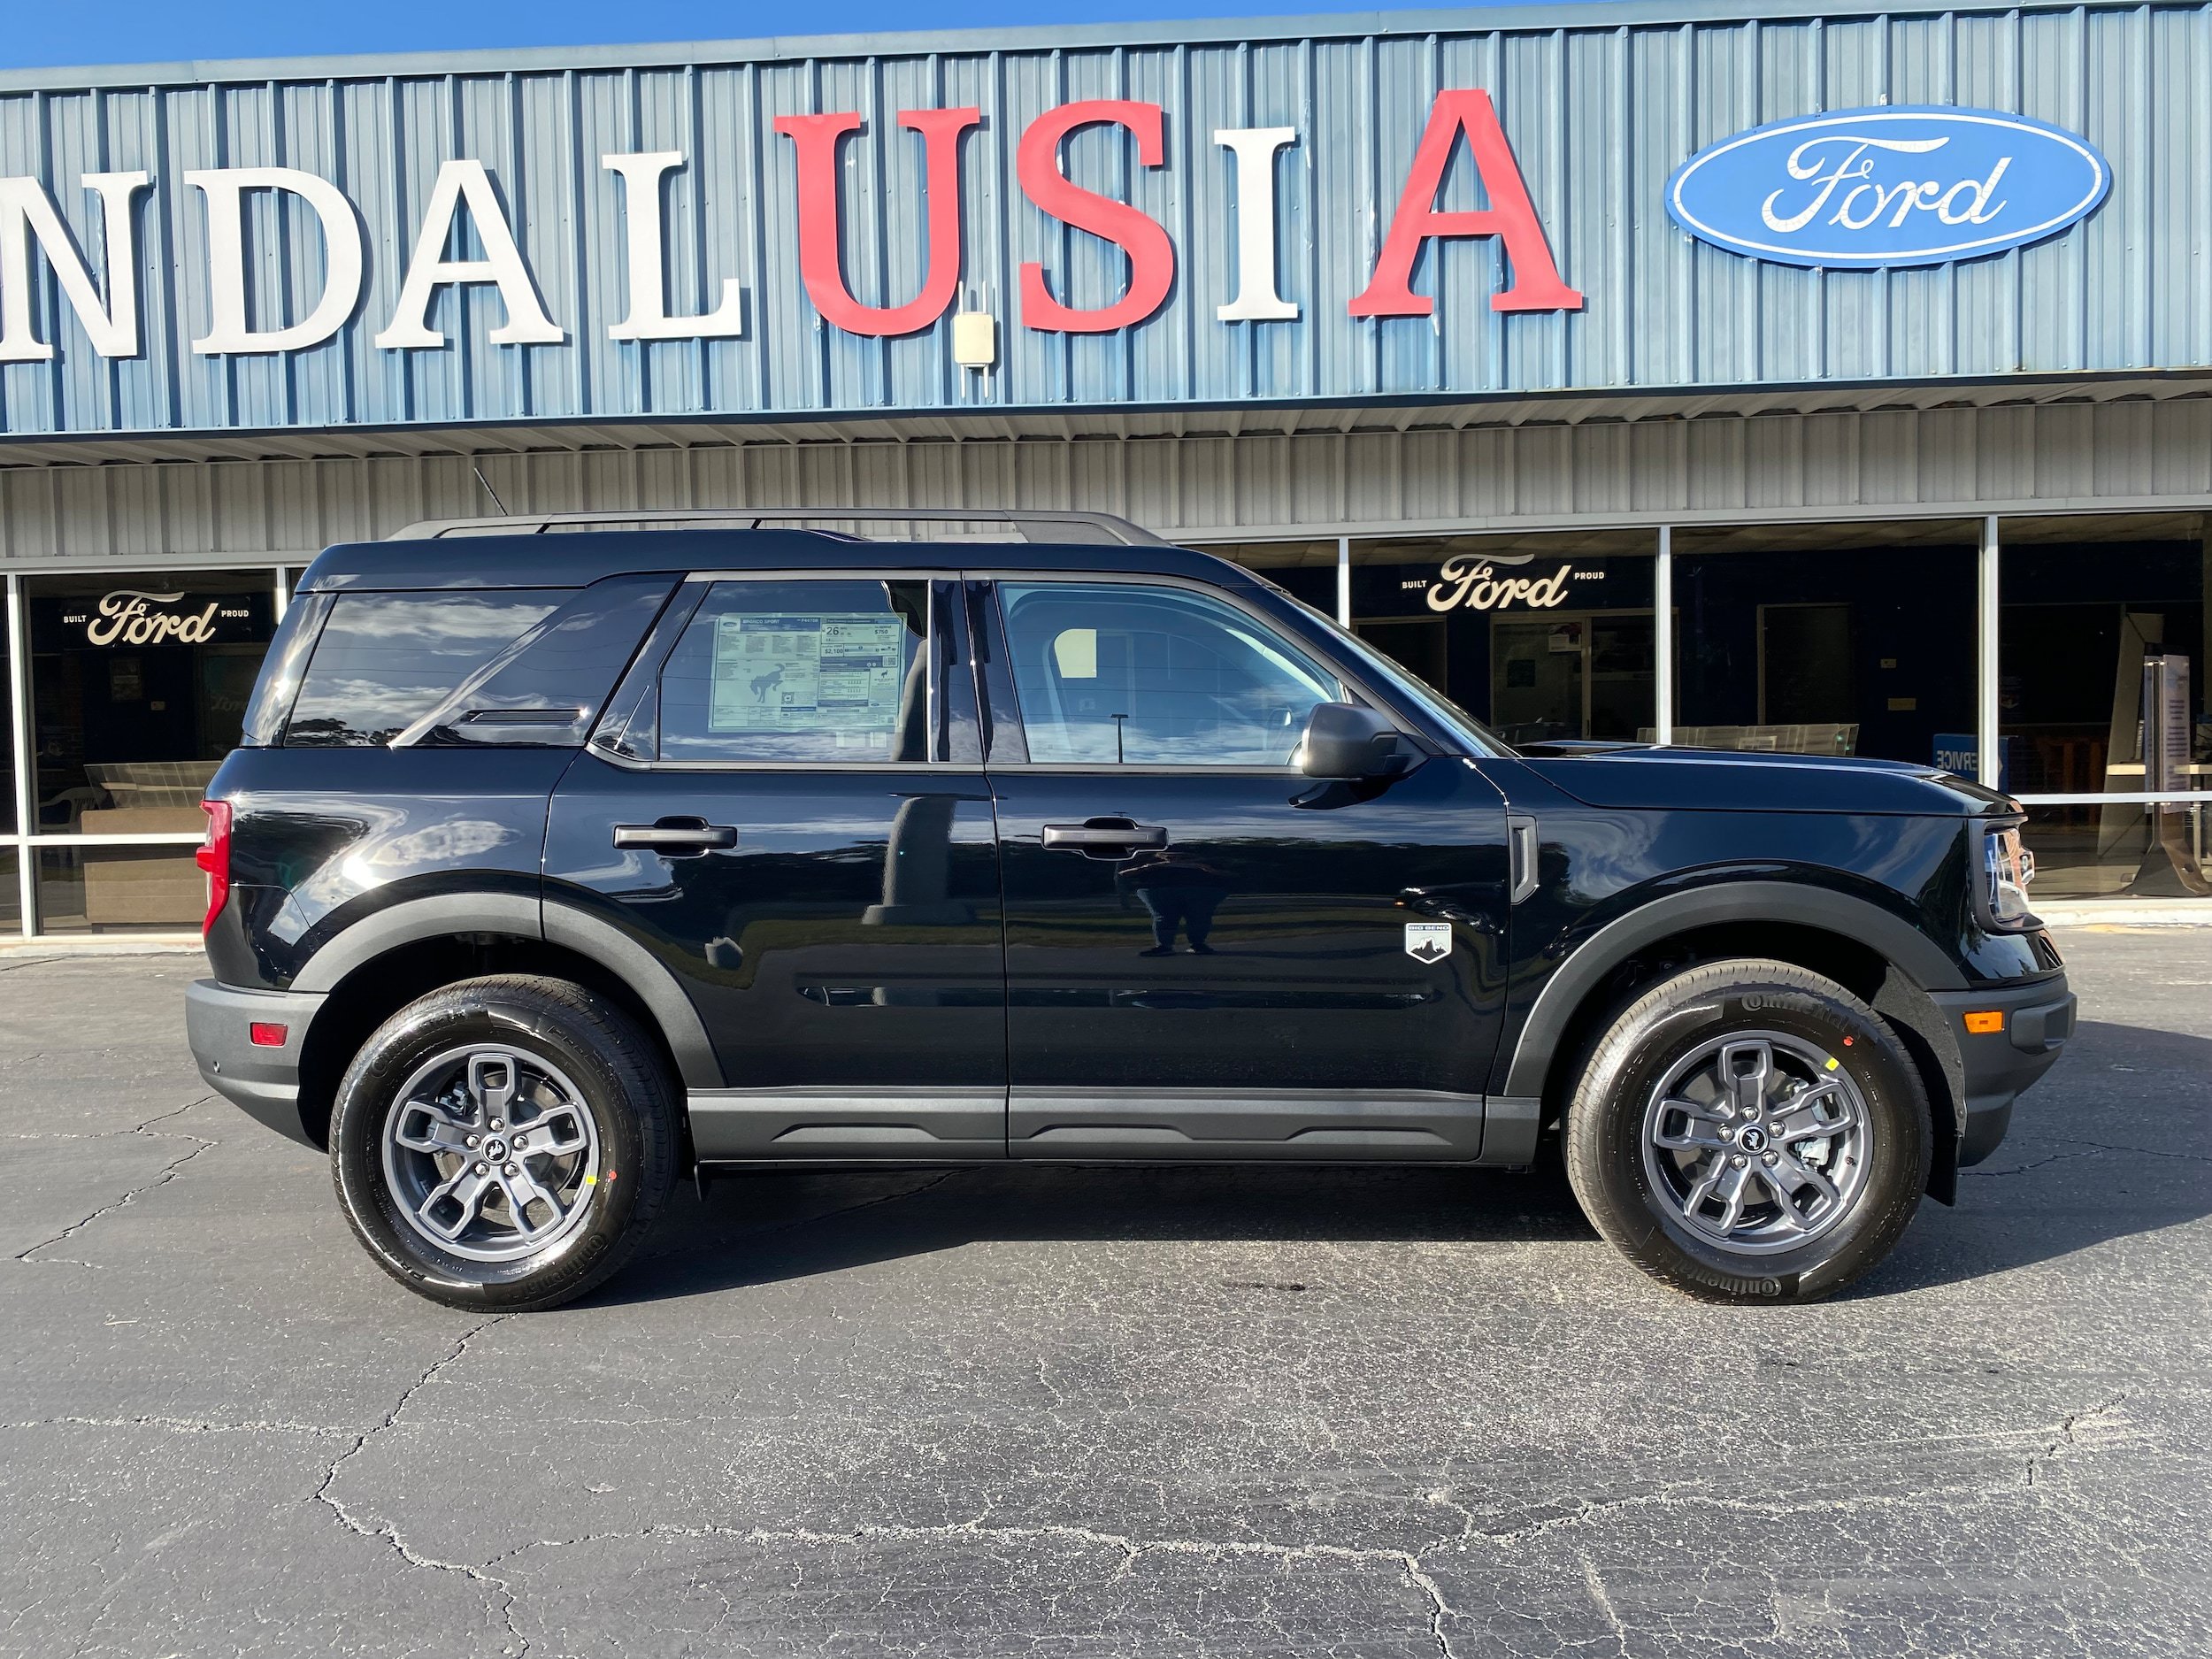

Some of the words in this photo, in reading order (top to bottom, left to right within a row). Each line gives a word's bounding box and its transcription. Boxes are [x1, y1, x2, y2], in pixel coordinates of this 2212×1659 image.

[1761, 135, 2012, 233] Ford
[1402, 580, 1427, 589] BUILT
[1426, 553, 1572, 612] Ford
[1574, 572, 1605, 580] PROUD
[63, 614, 87, 624] BUILT
[87, 589, 219, 646] Ford
[220, 609, 250, 618] PROUD
[826, 626, 840, 635] 26
